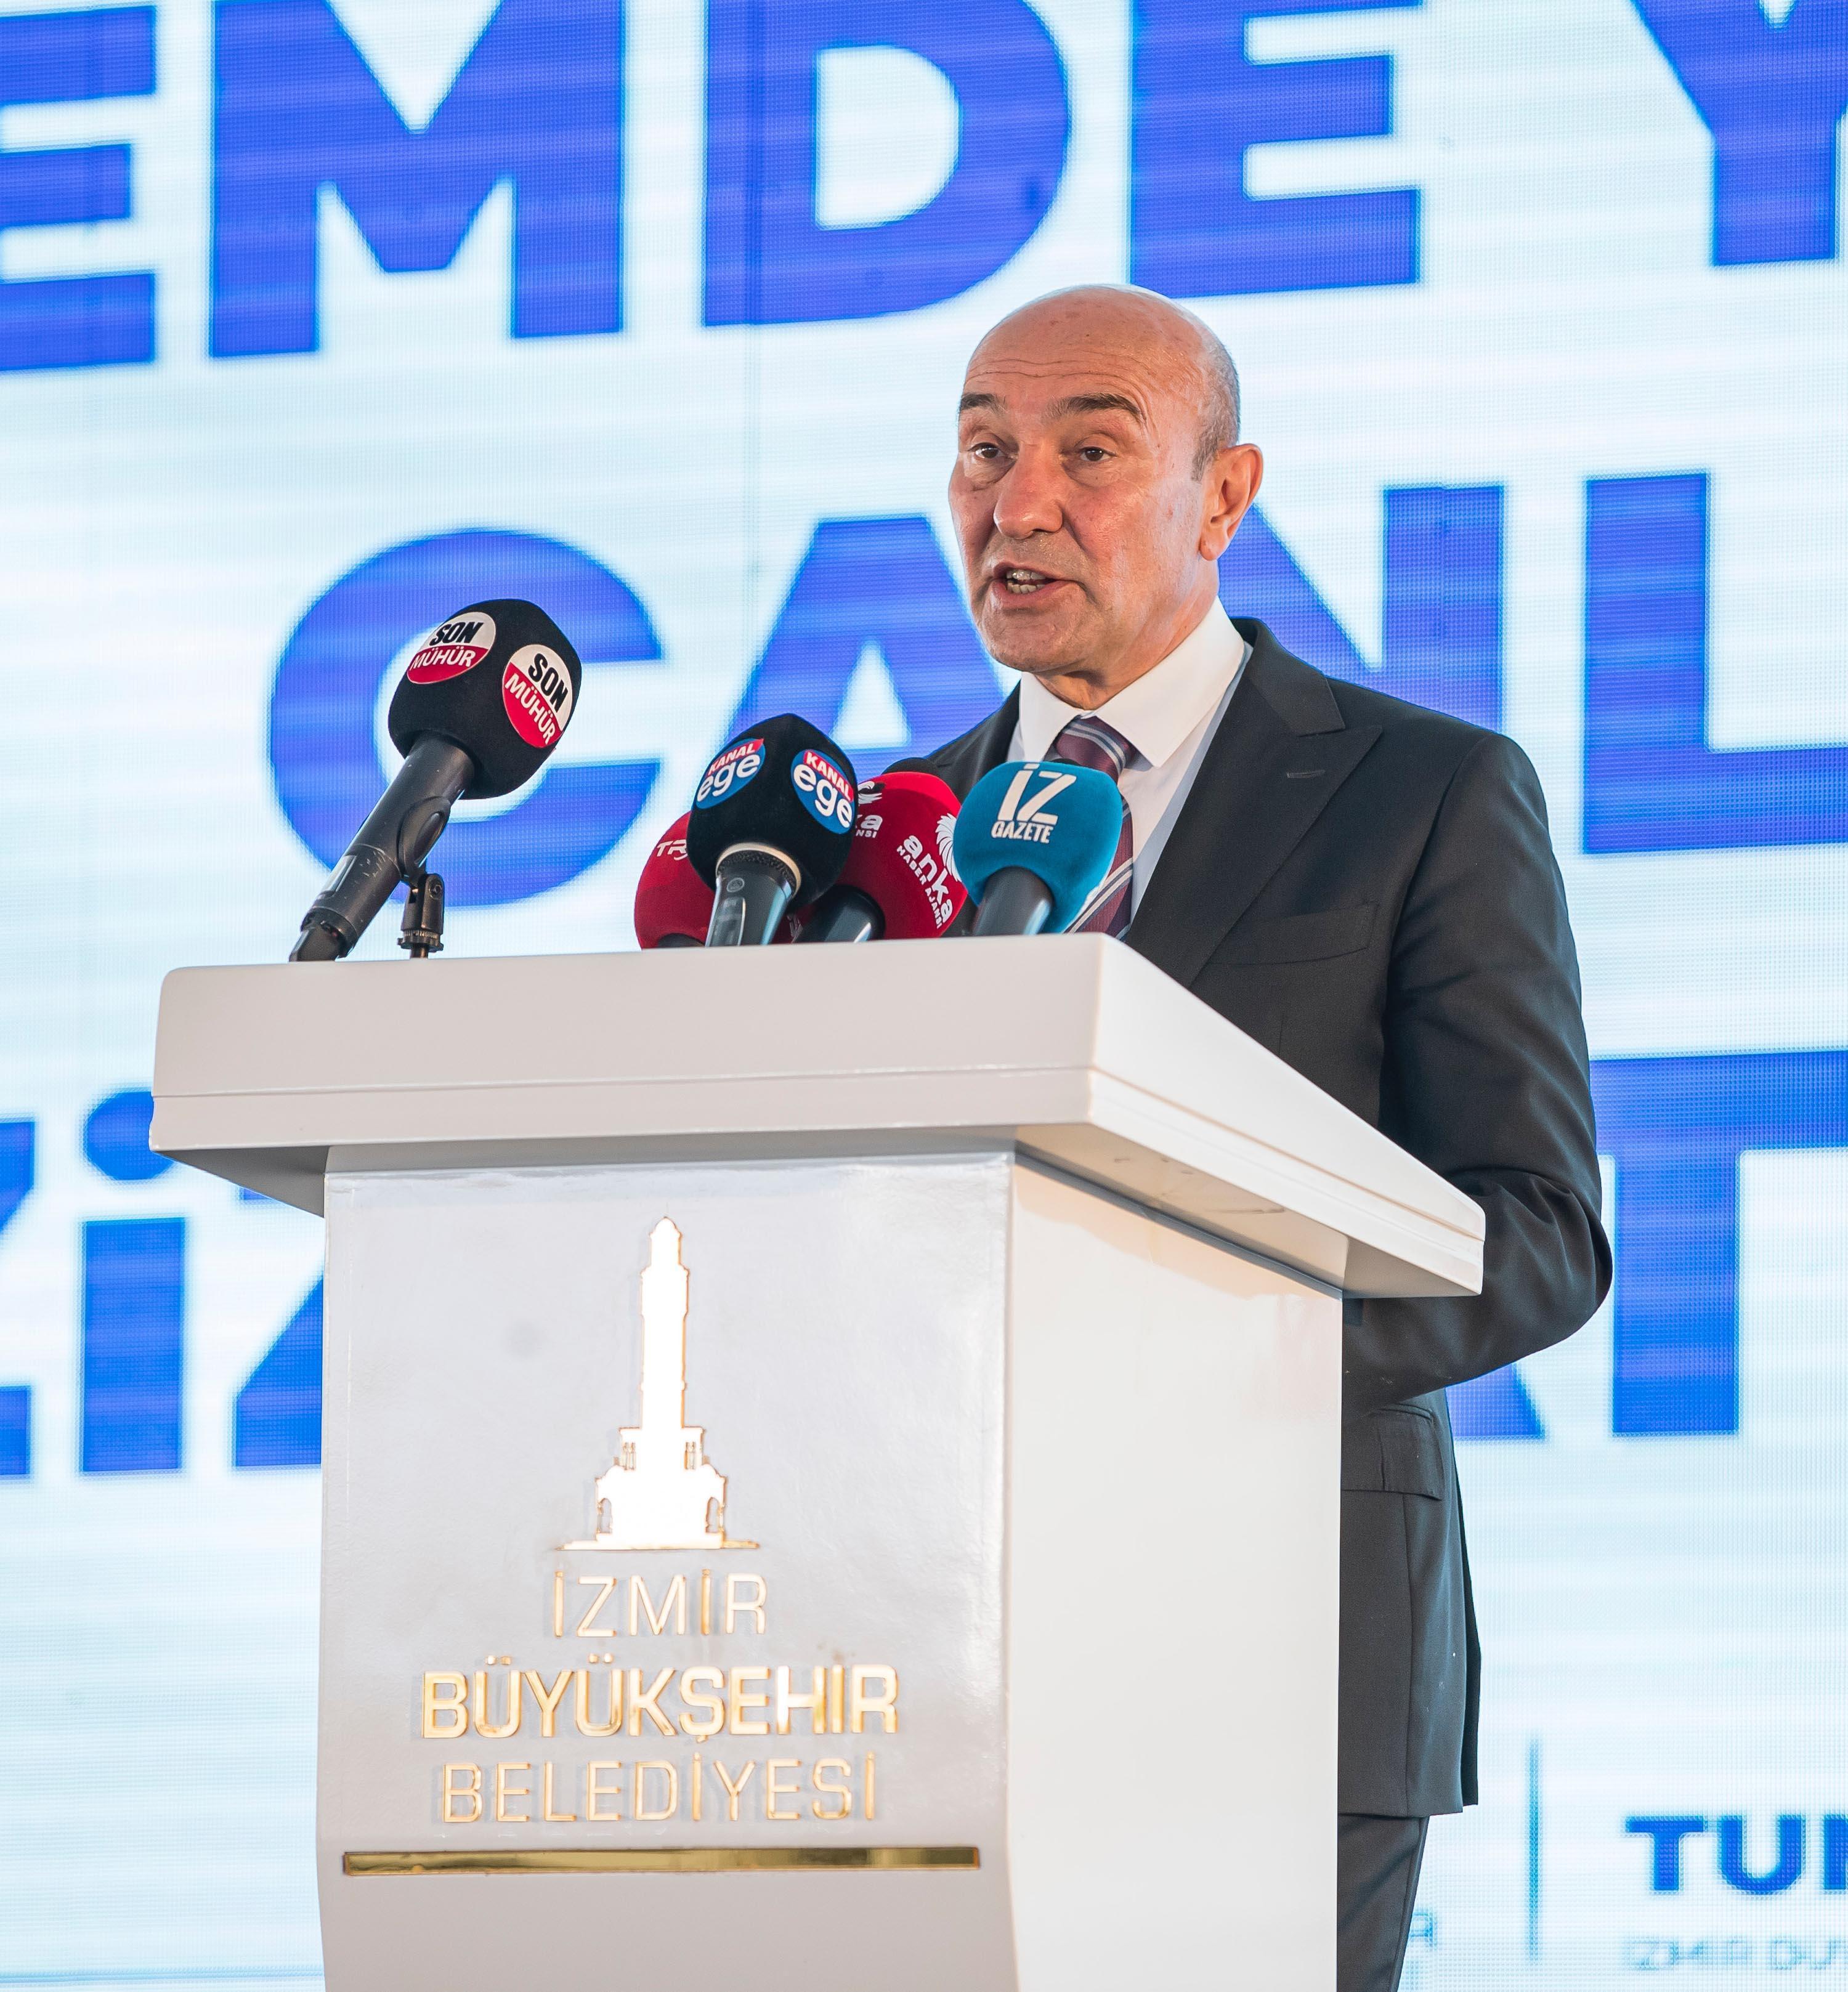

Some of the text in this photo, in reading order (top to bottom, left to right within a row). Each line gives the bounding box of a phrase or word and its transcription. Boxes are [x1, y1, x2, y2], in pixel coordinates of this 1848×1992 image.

[409, 646, 476, 671] MÜHÜR
[429, 621, 484, 646] SON
[505, 673, 556, 745] MÜHÜR
[528, 653, 569, 713] SON
[697, 754, 761, 802] ege
[708, 743, 756, 775] KANAL
[806, 751, 853, 802] KANAL
[793, 764, 853, 828] ege
[997, 763, 1077, 825] İZ
[657, 839, 687, 857] TR
[991, 820, 1054, 843] GAZETE
[896, 845, 942, 929] HABER AJANSI
[903, 835, 953, 923] anka
[554, 1568, 768, 1638] İZMİR
[442, 1751, 876, 1823] BELEDİYESİ
